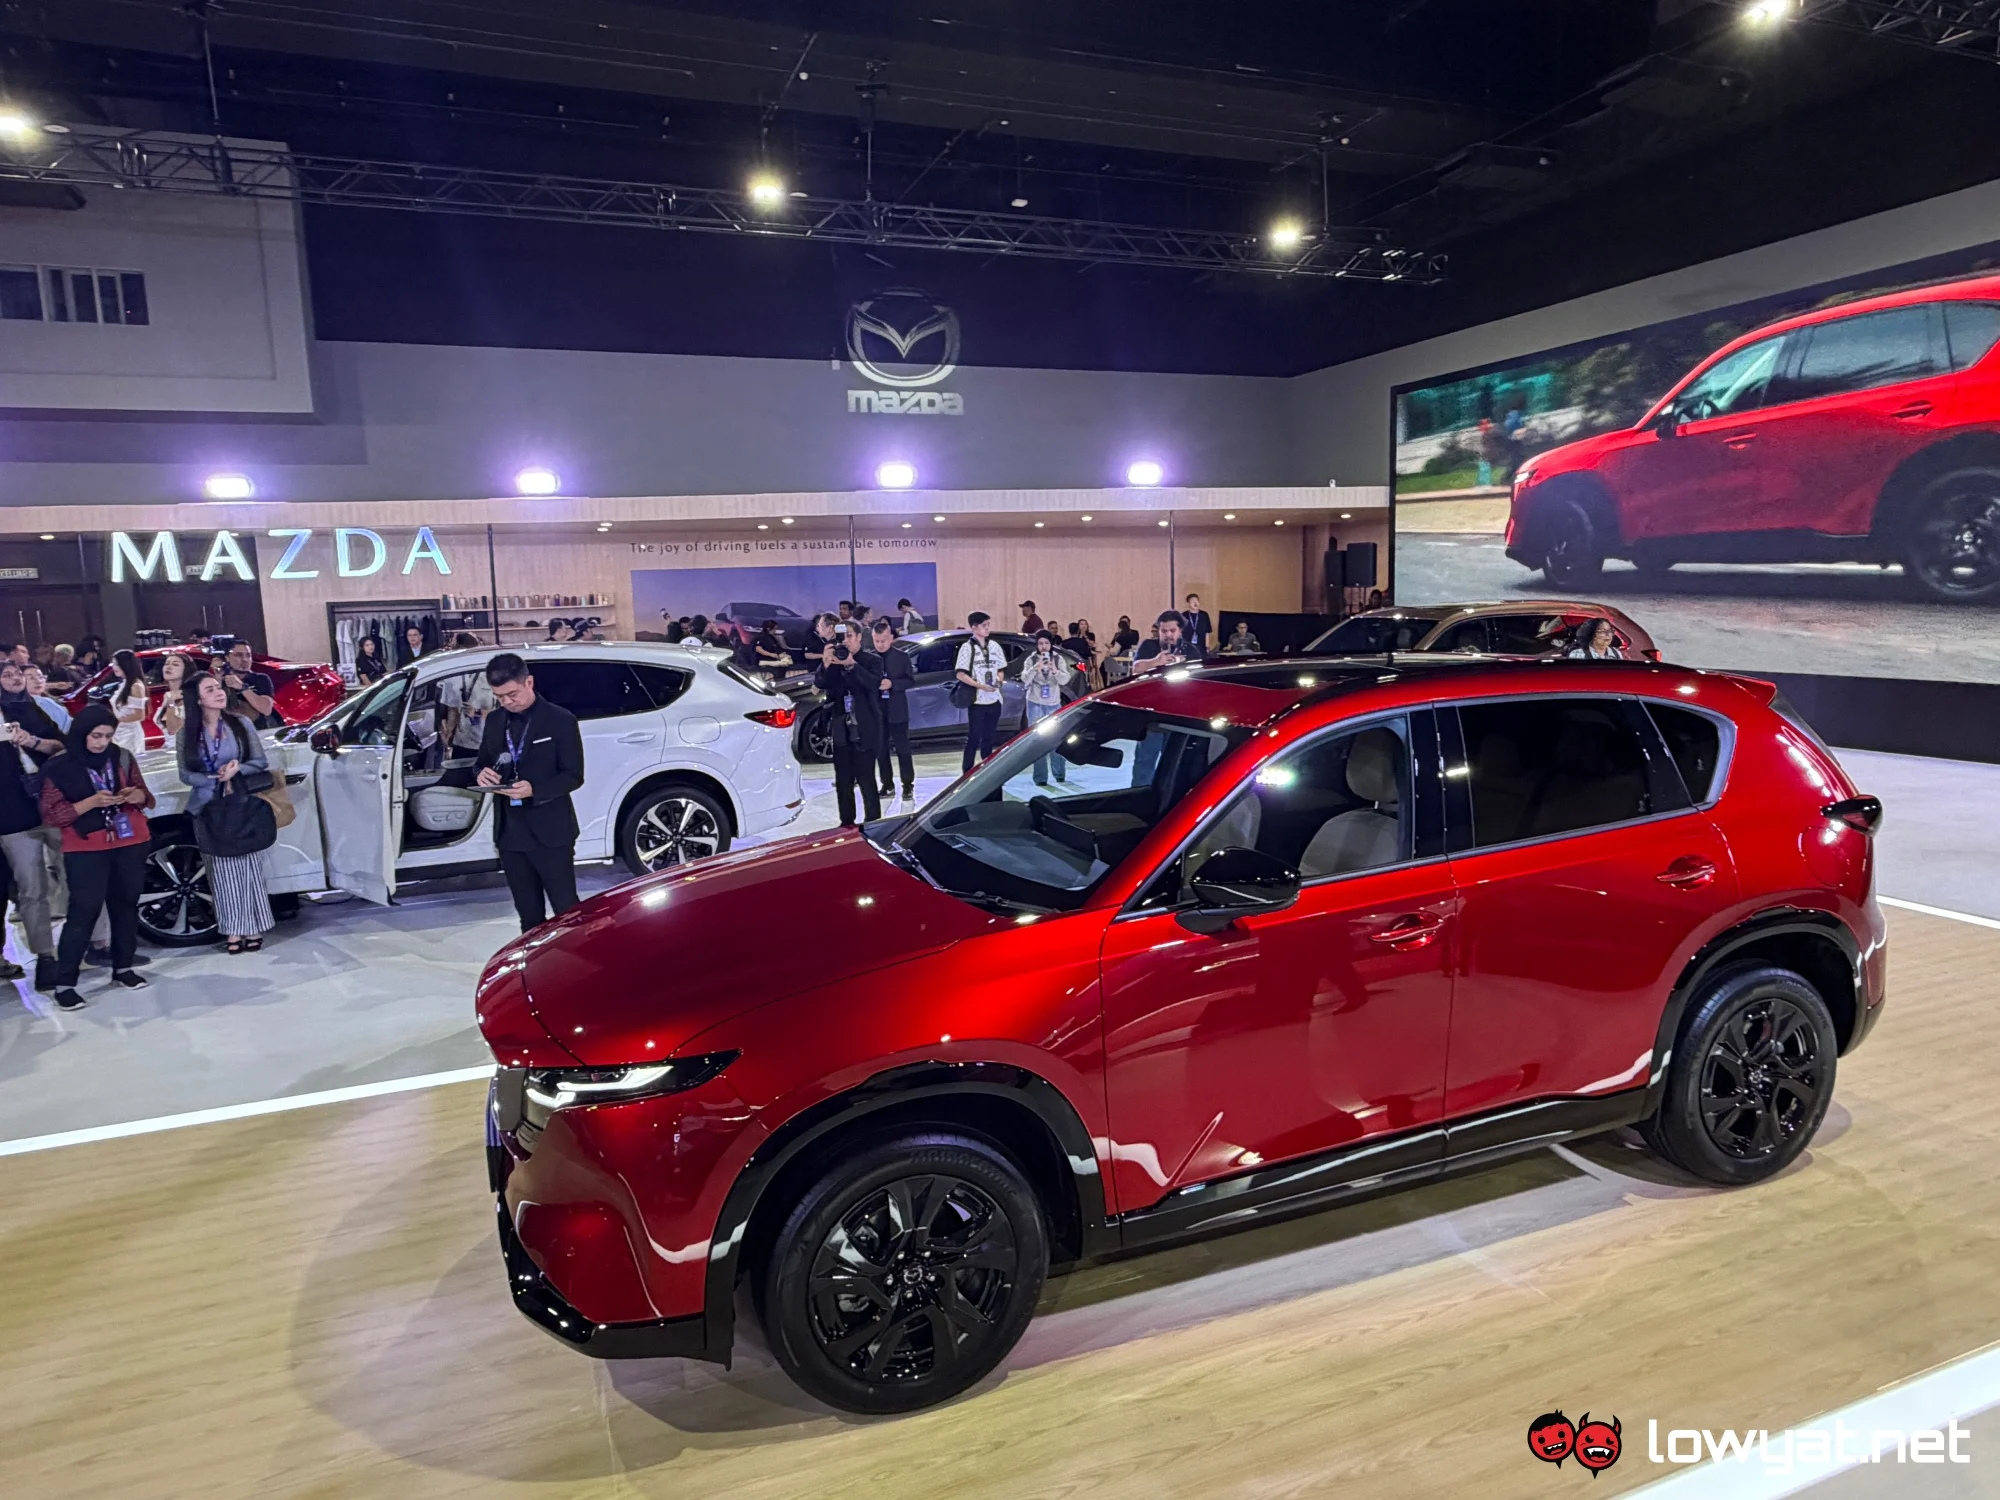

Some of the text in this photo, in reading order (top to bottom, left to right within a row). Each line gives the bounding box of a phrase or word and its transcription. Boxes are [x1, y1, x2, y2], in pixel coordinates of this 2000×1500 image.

[110, 526, 452, 583] MAZDA
[629, 537, 938, 556] The joy of driving fuels a sustainable tomorrow
